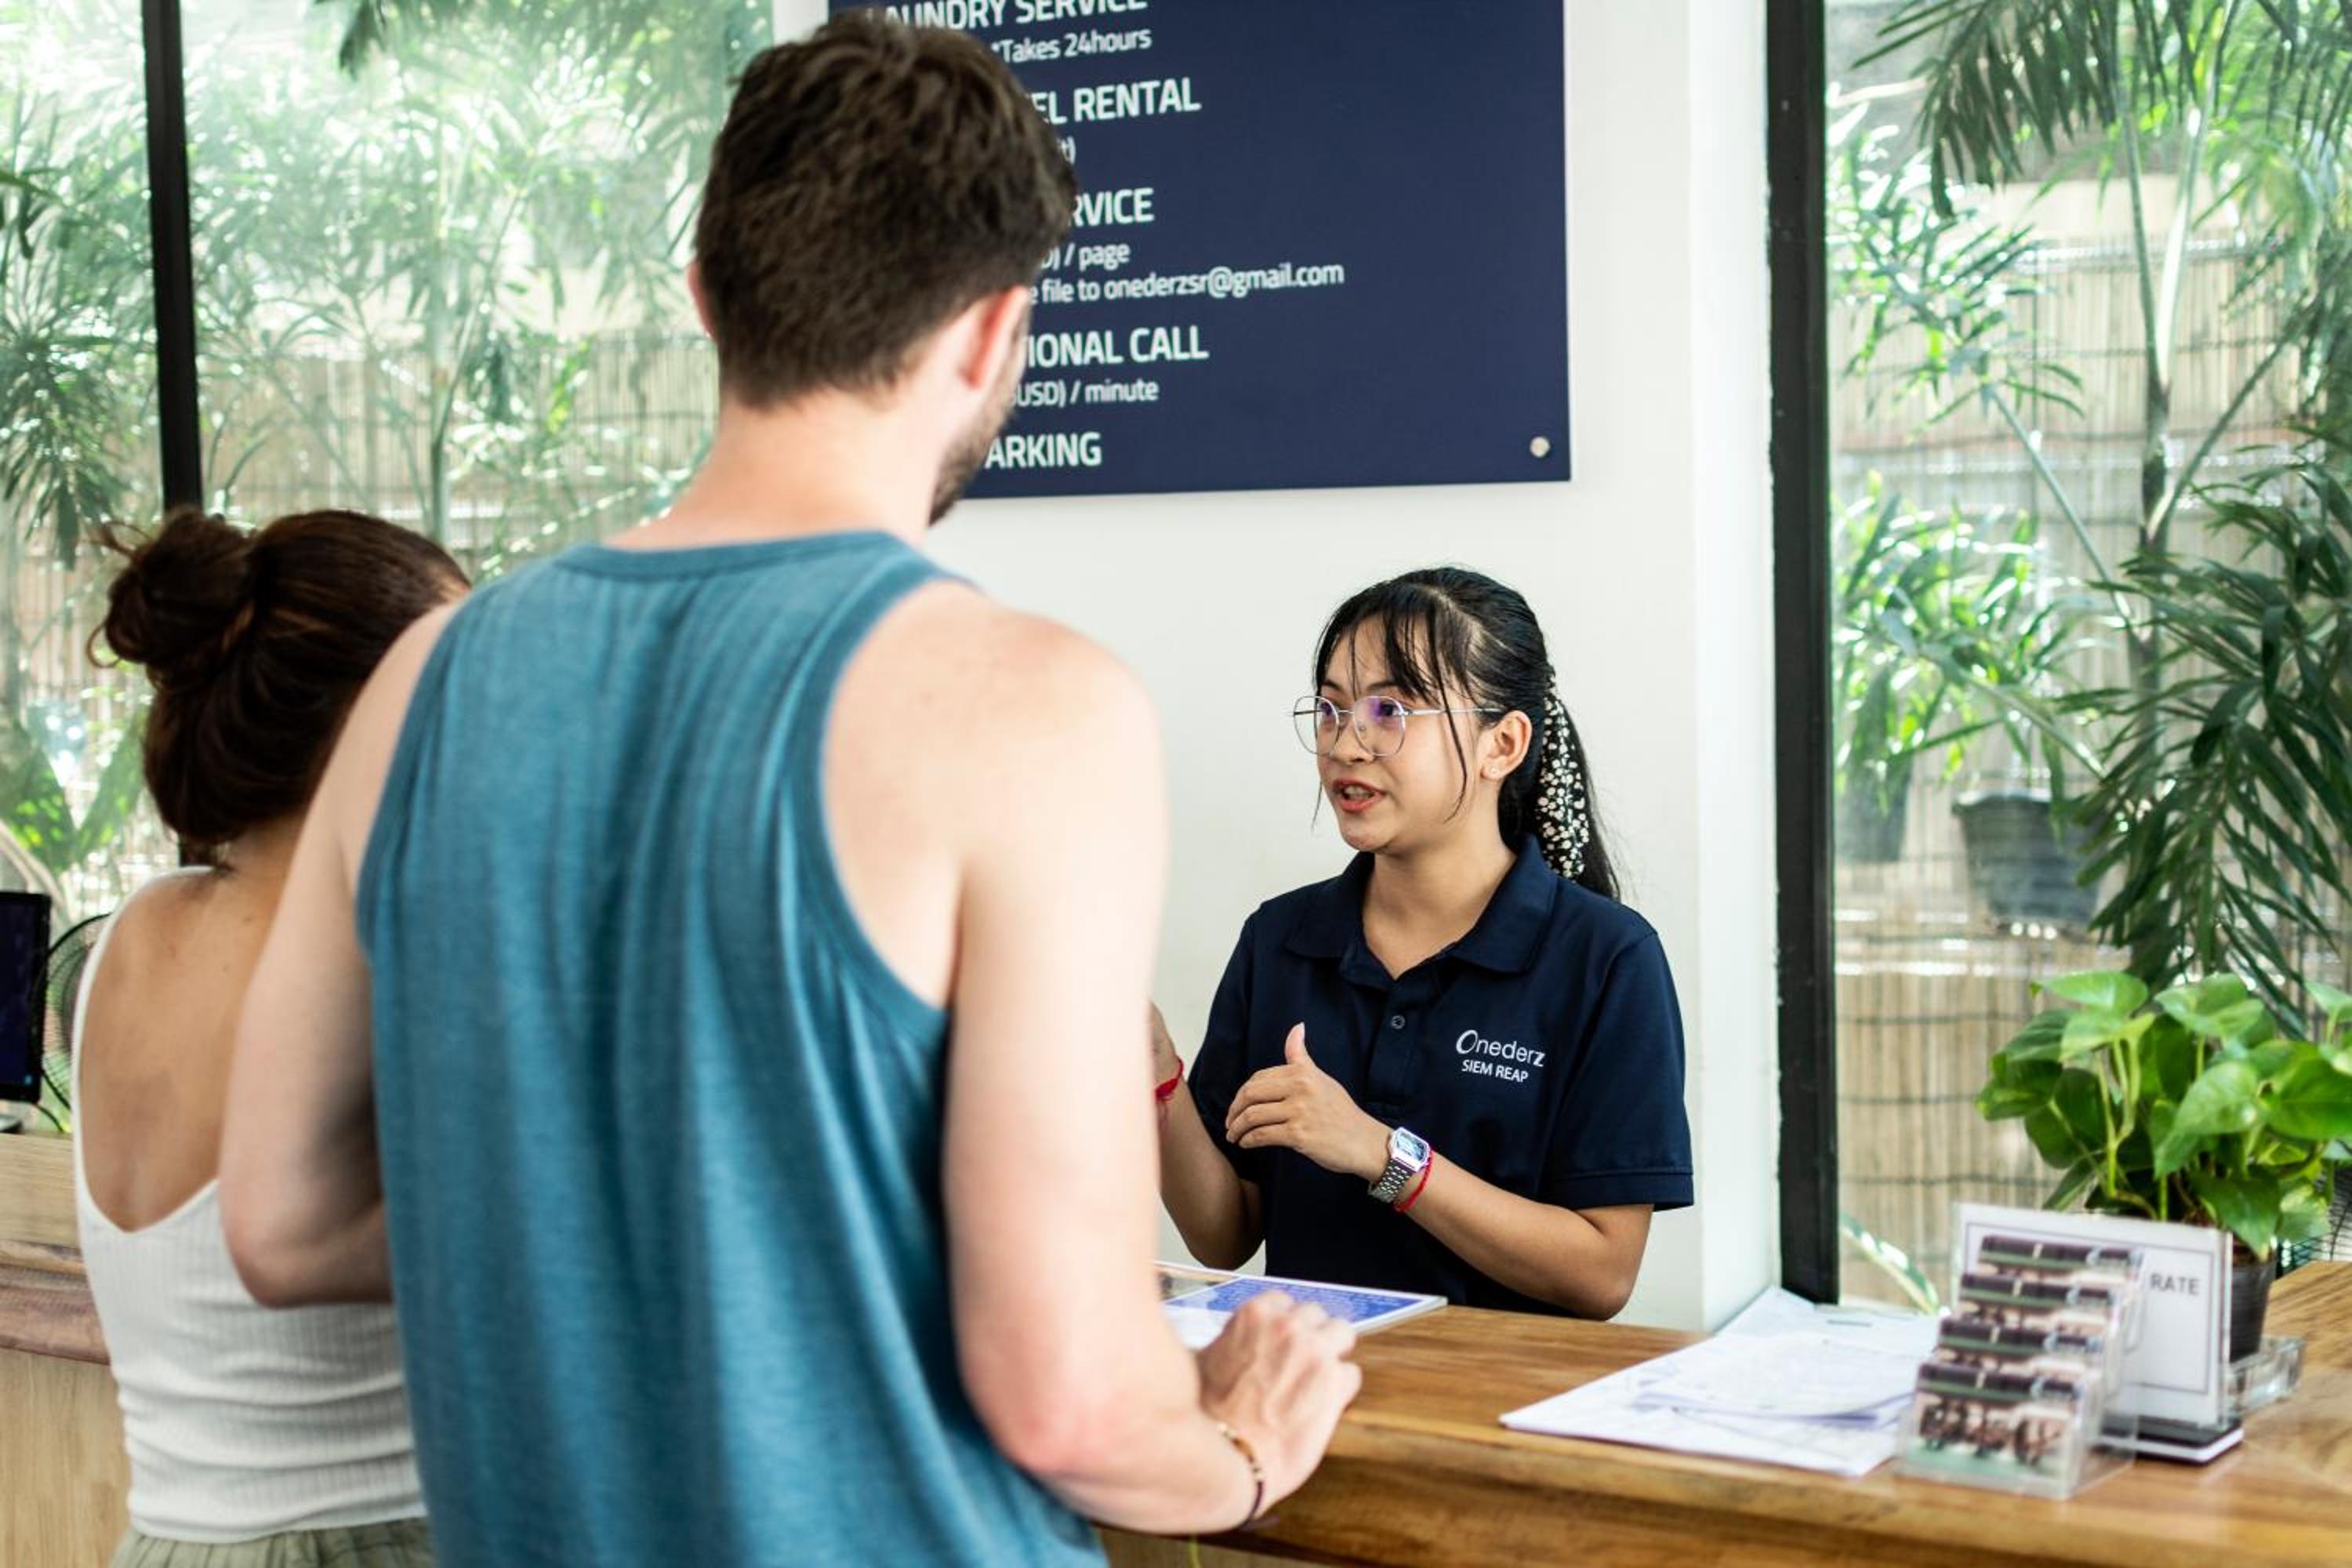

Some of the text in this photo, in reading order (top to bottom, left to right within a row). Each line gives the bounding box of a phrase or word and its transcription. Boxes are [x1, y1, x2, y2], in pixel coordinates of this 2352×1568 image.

[866, 0, 1007, 30] AUNDRY
[1064, 28, 1152, 57] 24hours
[1029, 76, 1202, 125] EL RENTAL
[1071, 187, 1155, 227] RVICE
[1079, 243, 1131, 272] page
[1042, 277, 1075, 303] file
[1077, 278, 1100, 302] to
[1104, 262, 1345, 300] onederzsr@gmail.com
[1028, 325, 1210, 368] IONAL CALL
[1015, 378, 1160, 408] USD) / minute
[985, 431, 1102, 469] ARKING
[1455, 1029, 1546, 1067] Onederz
[1461, 1058, 1529, 1083] SIEM REAP
[2150, 1272, 2200, 1296] RATE
